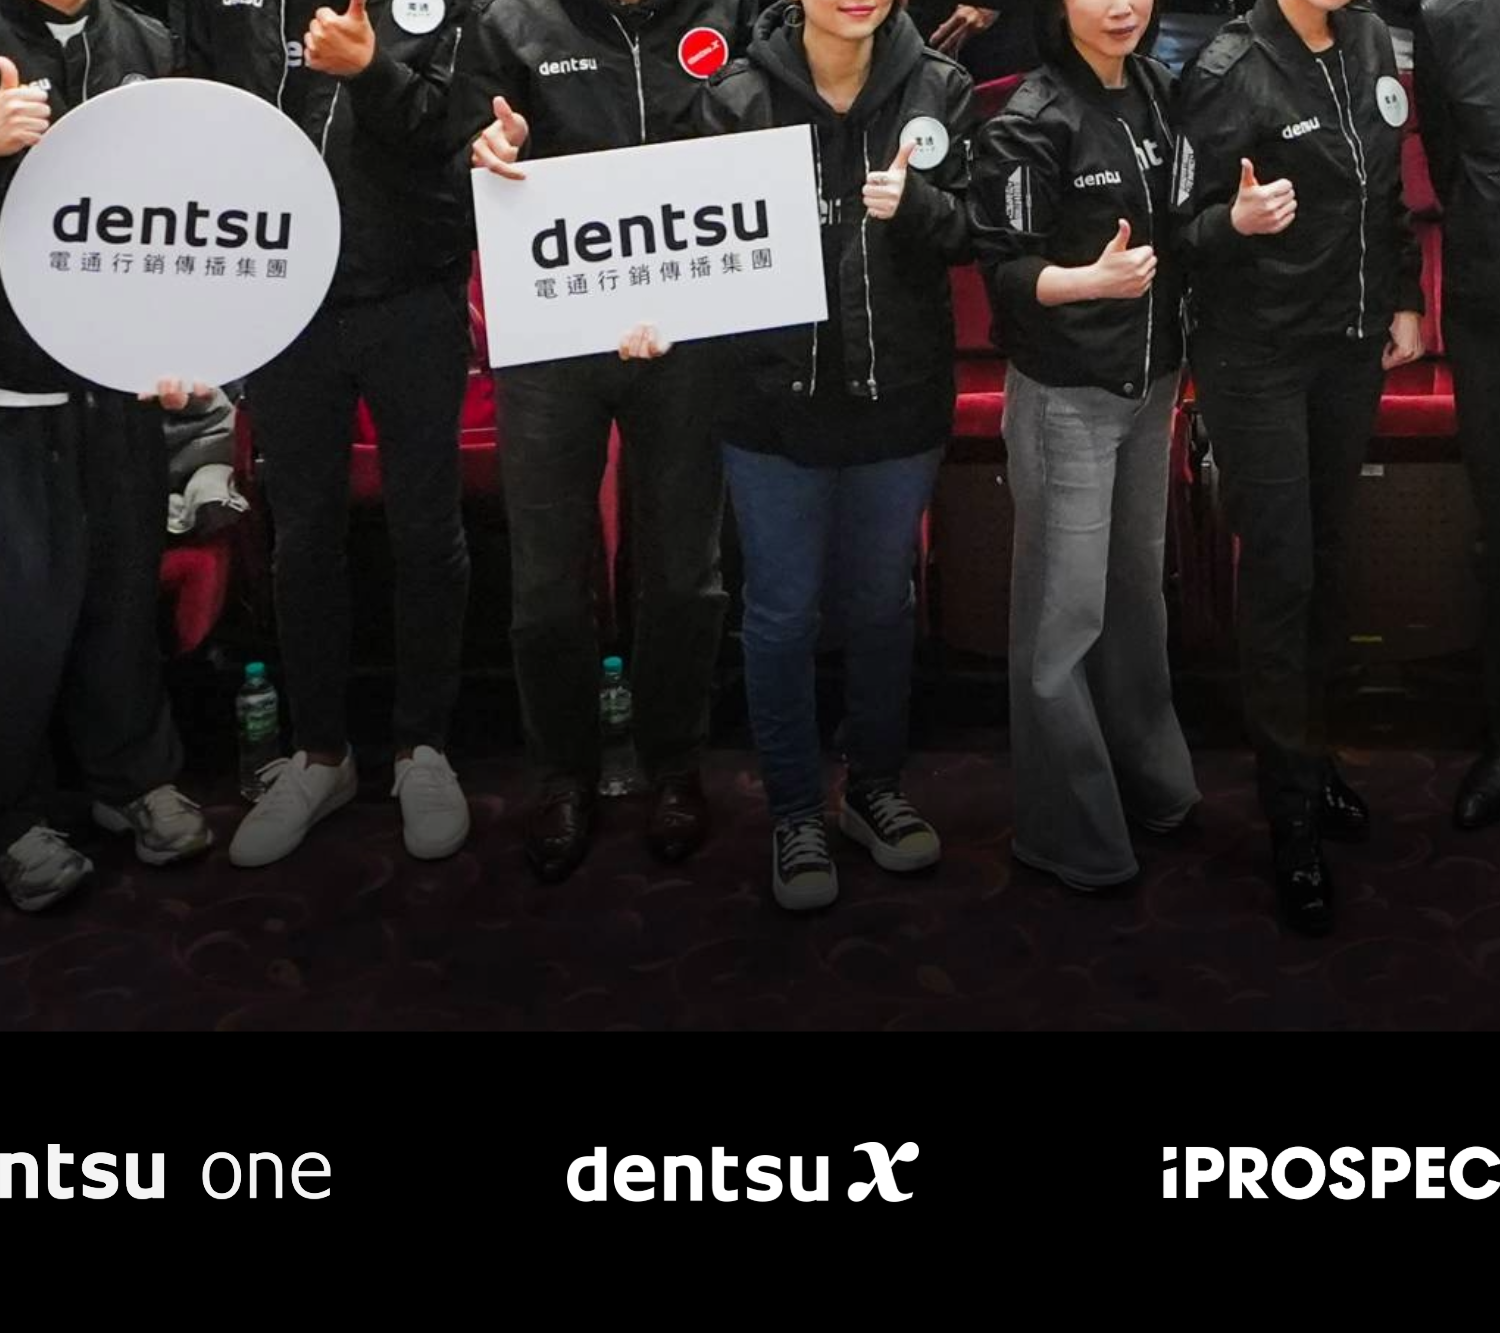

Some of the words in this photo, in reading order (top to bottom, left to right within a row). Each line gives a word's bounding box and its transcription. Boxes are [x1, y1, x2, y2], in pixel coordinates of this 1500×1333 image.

[539, 56, 598, 76] dentsu
[51, 197, 292, 249] dentsu
[531, 197, 770, 269] dentsu
[49, 250, 288, 279] 電通行銷傳播集團
[533, 248, 773, 301] 電通行銷傳播集團
